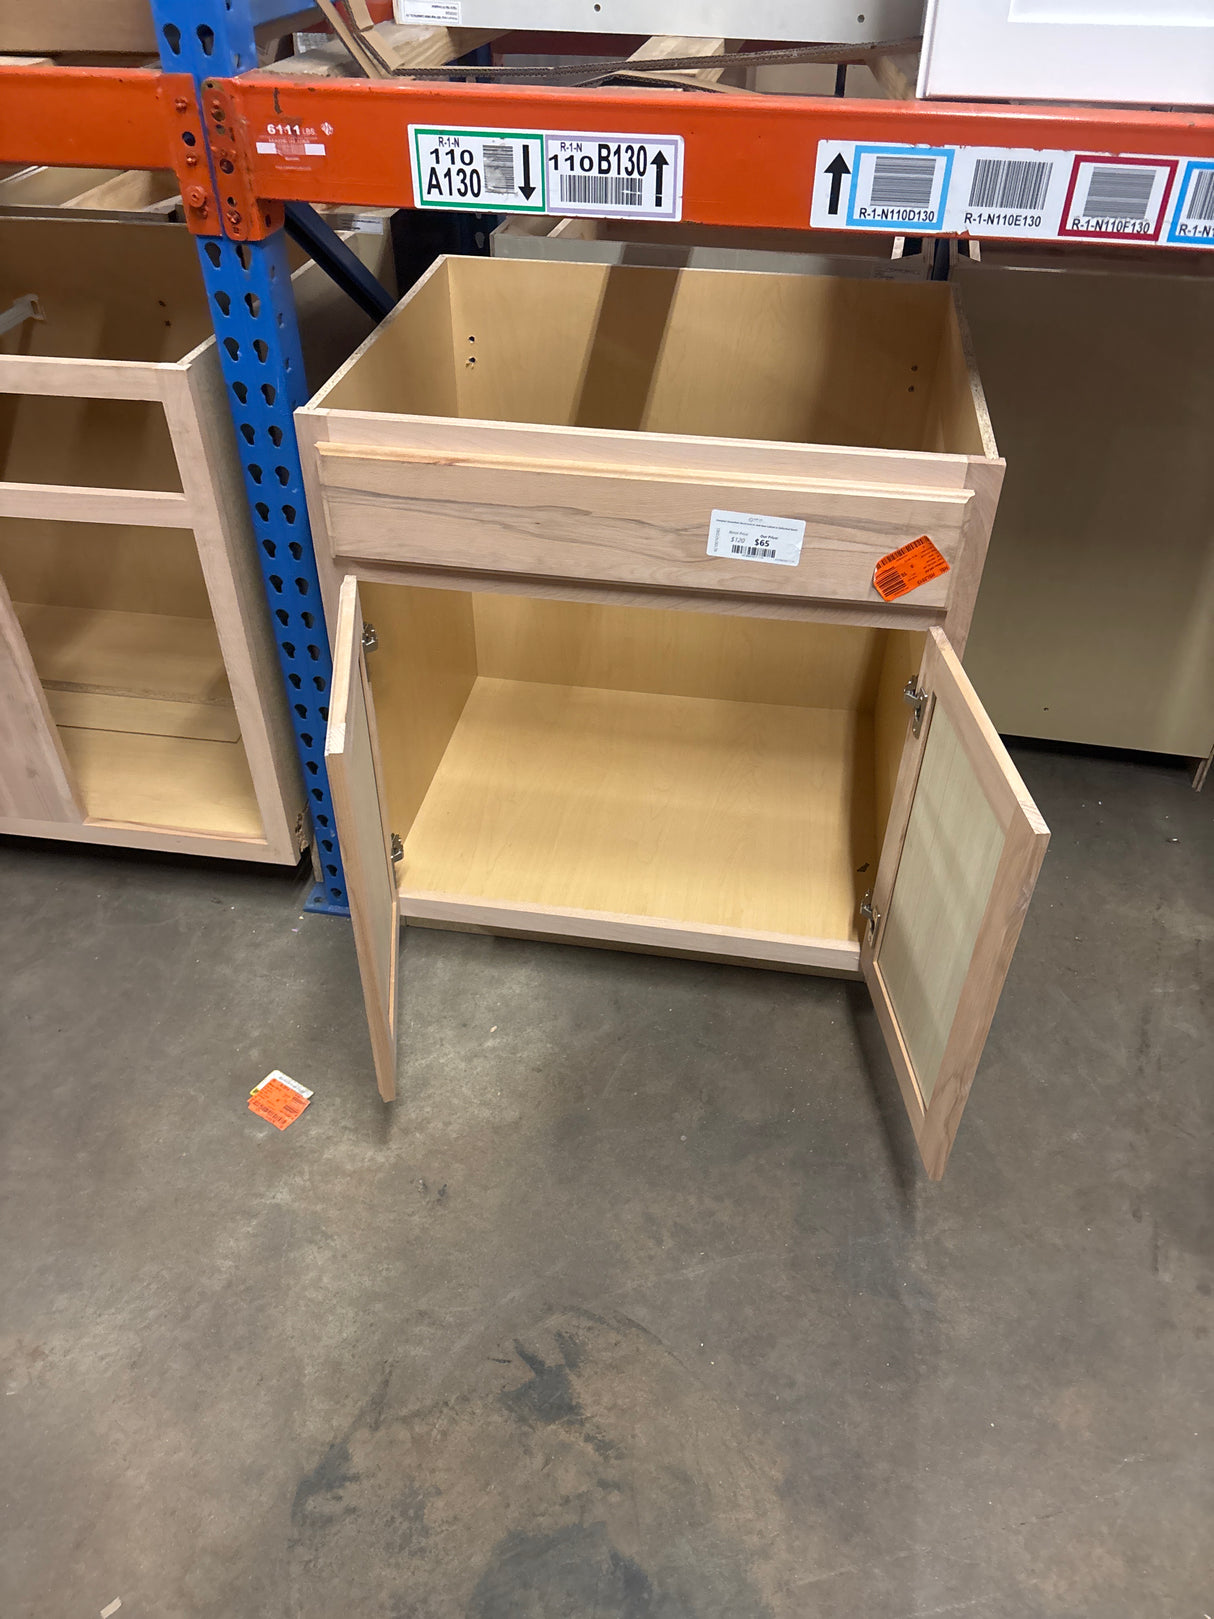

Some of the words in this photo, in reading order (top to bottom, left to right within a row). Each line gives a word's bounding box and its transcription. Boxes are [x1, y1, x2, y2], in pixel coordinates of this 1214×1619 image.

[267, 123, 300, 135] 6111
[438, 137, 460, 148] R-1-N
[560, 142, 583, 153] R-1-N
[430, 148, 474, 166] 110
[548, 154, 594, 172] 110
[597, 143, 648, 177] B130
[427, 166, 481, 198] A130
[858, 207, 935, 223] R-1-N110D130
[964, 212, 1042, 228] R-1-N110E130
[1071, 218, 1151, 234] R-1-N110F130
[754, 538, 770, 547] $65
